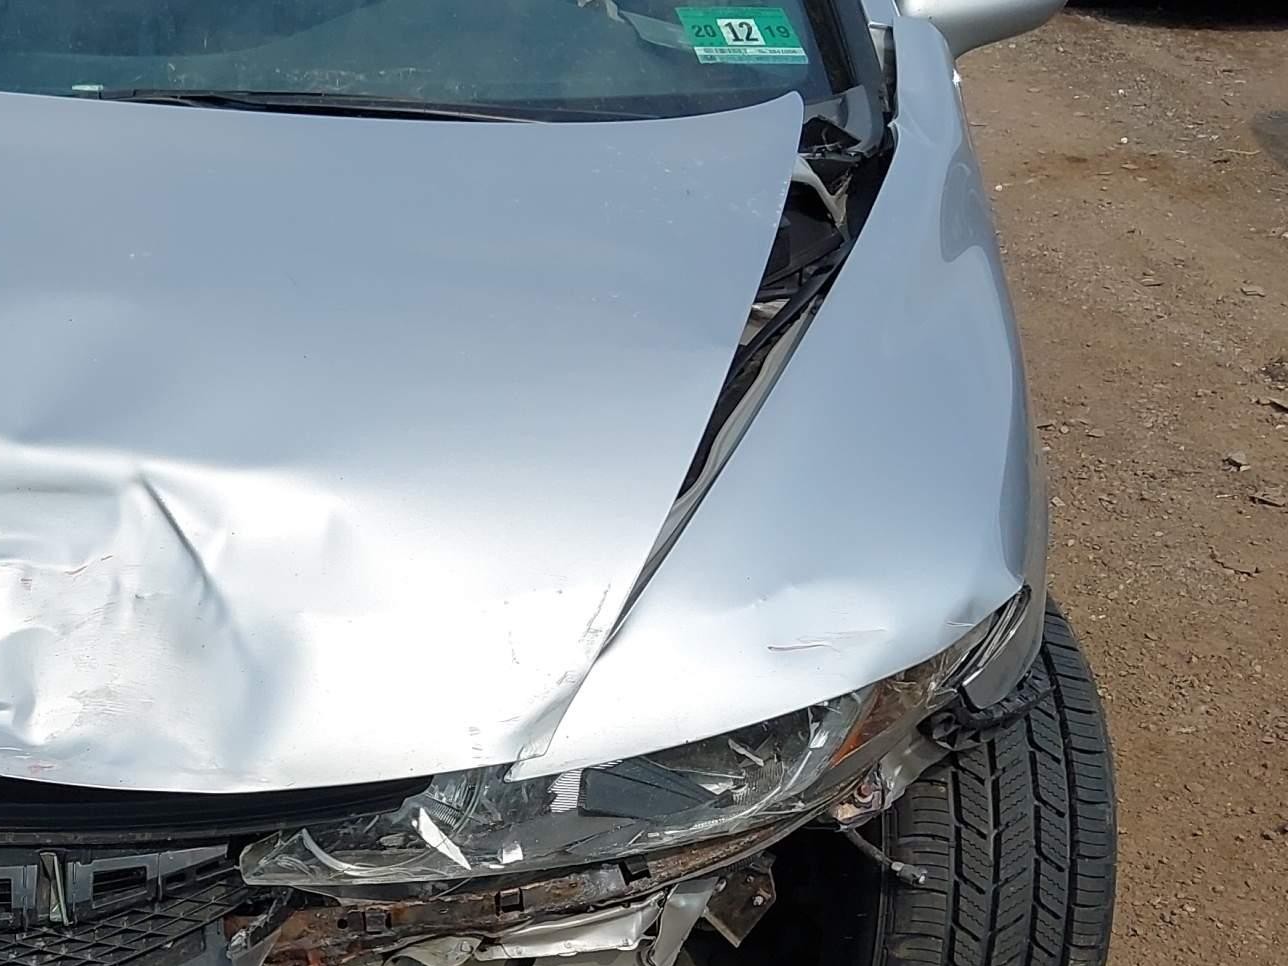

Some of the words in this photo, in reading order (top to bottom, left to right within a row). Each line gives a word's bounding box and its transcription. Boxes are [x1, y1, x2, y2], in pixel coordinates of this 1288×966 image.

[692, 24, 717, 38] 20
[724, 21, 759, 42] 12
[764, 25, 791, 39] 19
